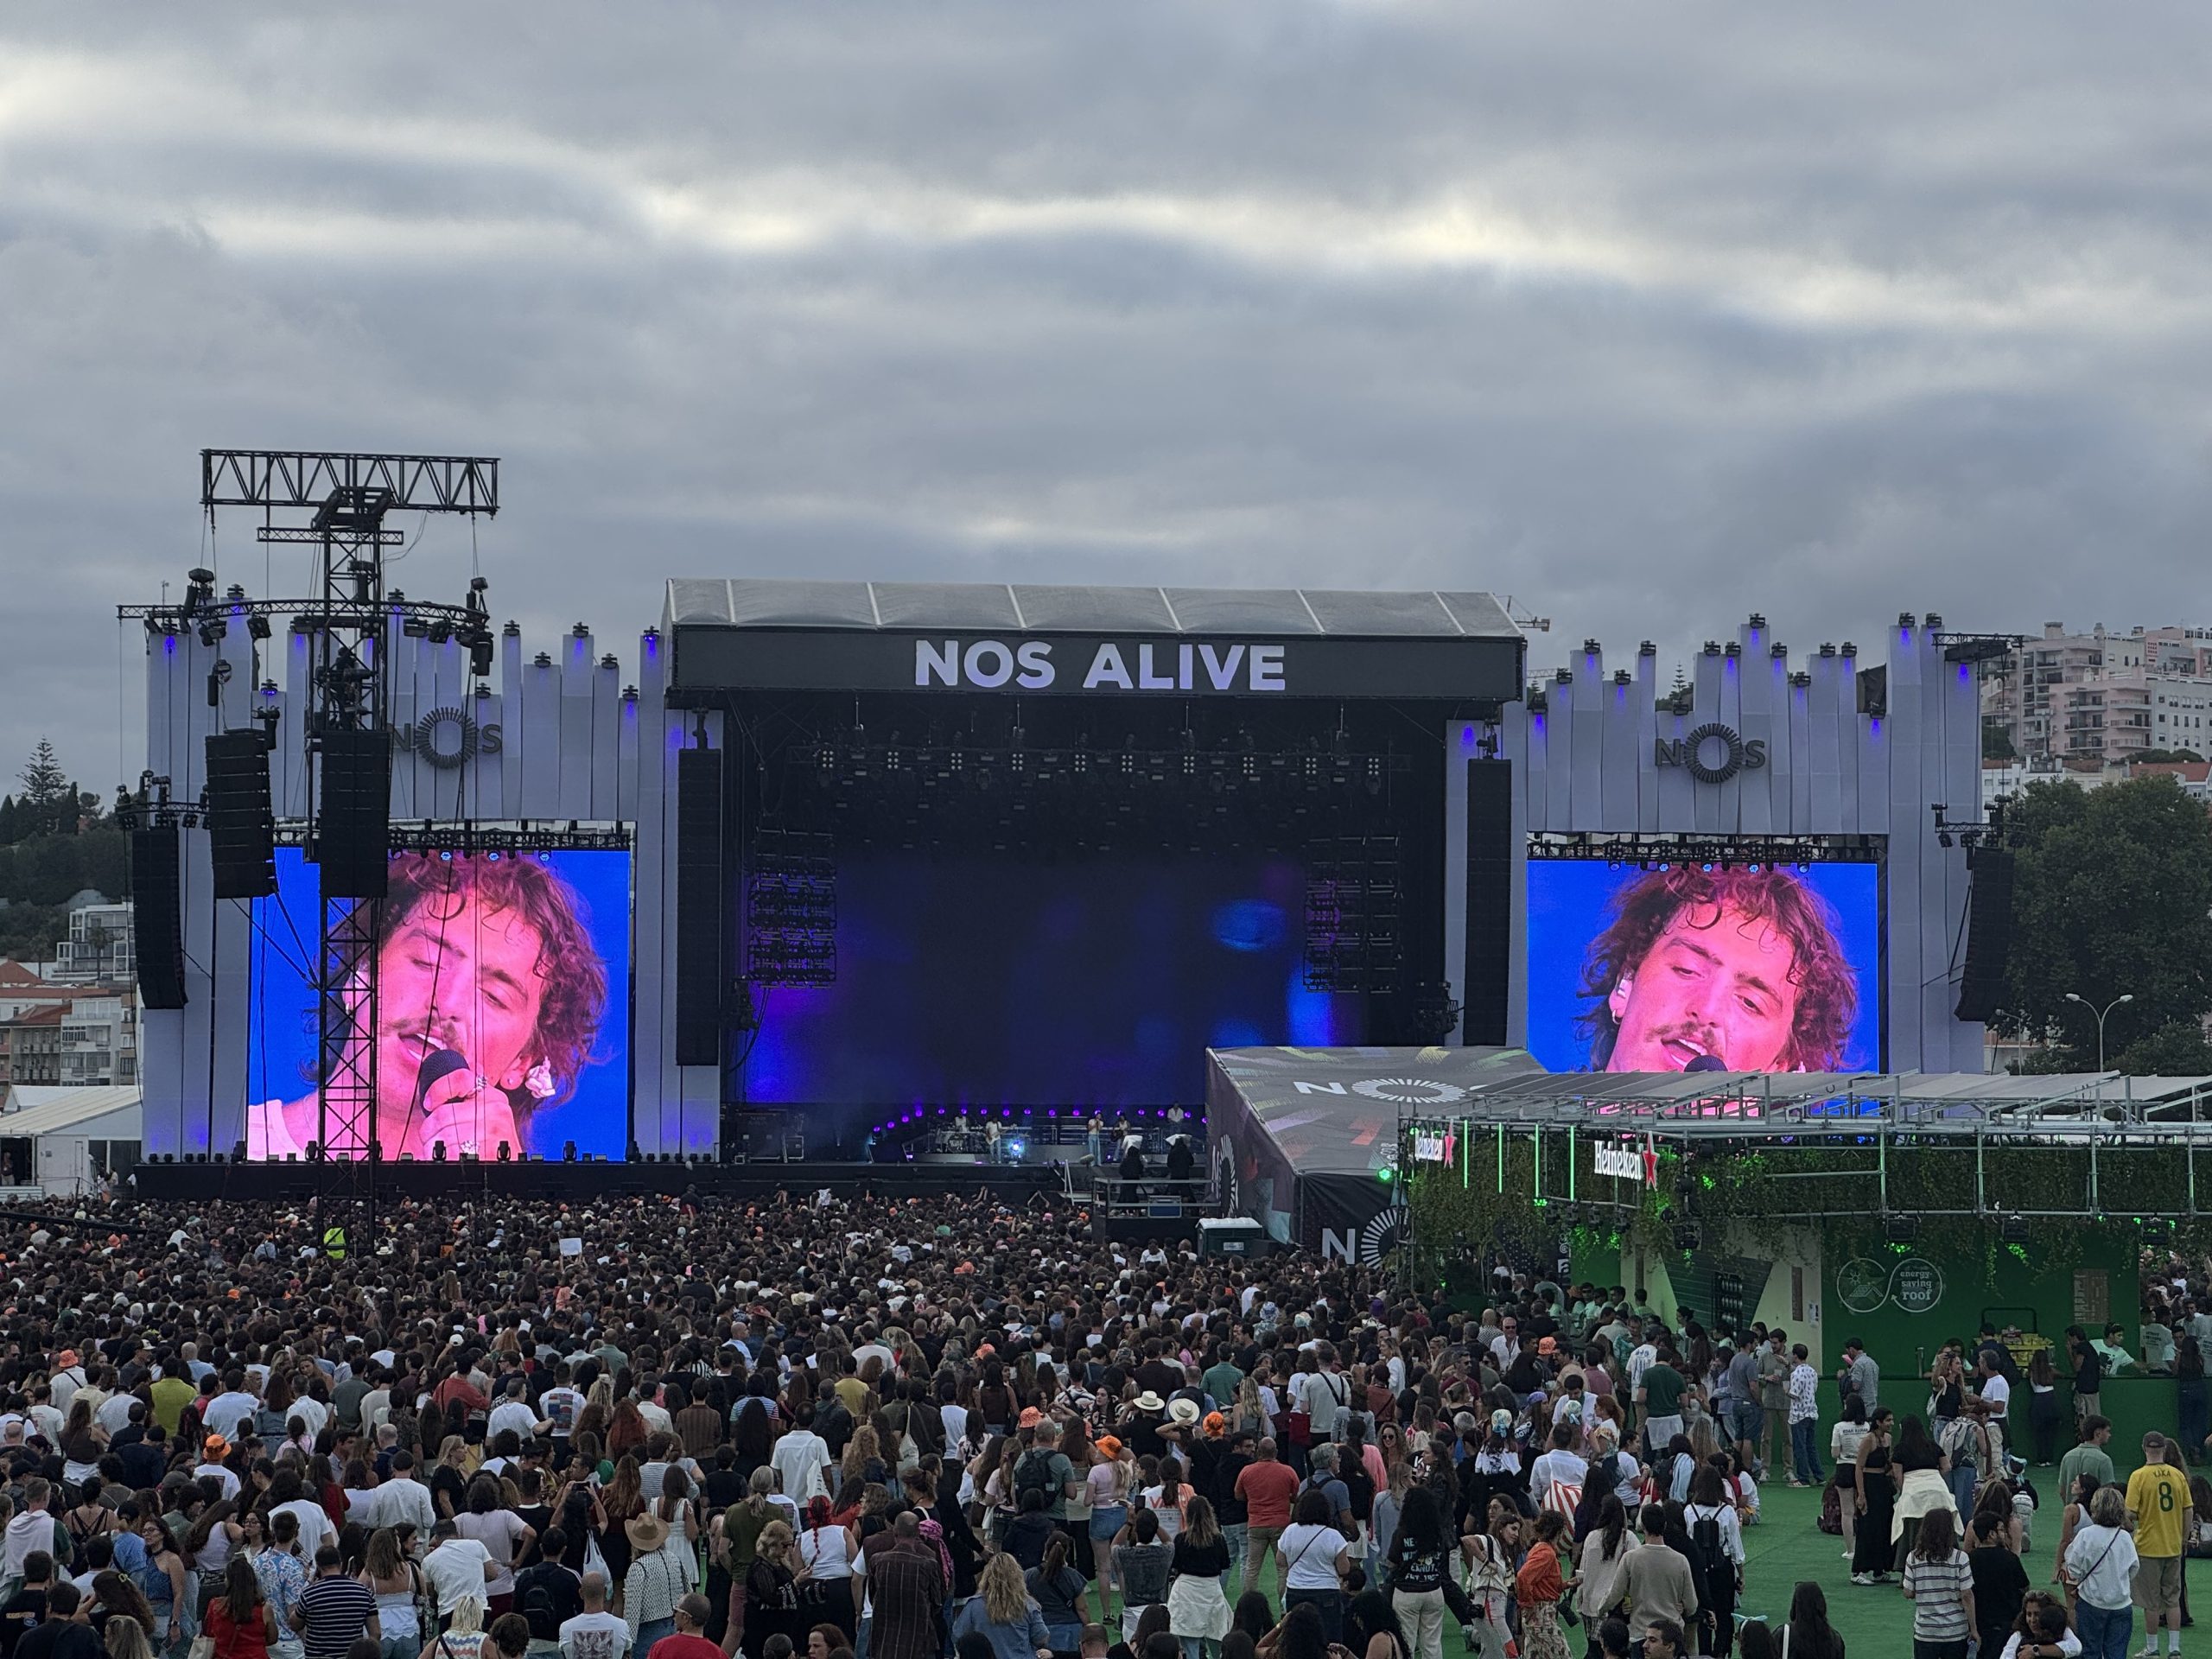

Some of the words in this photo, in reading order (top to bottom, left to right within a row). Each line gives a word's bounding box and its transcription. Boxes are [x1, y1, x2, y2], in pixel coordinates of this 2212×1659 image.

[915, 639, 1056, 689] NOS
[1082, 643, 1287, 690] ALIVE
[386, 707, 503, 769] NOS
[1655, 723, 1766, 783] NOS
[1594, 1140, 1643, 1180] Heineken
[1901, 1279, 1932, 1288] saving
[1902, 1289, 1932, 1300] roof
[2158, 1481, 2174, 1512] 8
